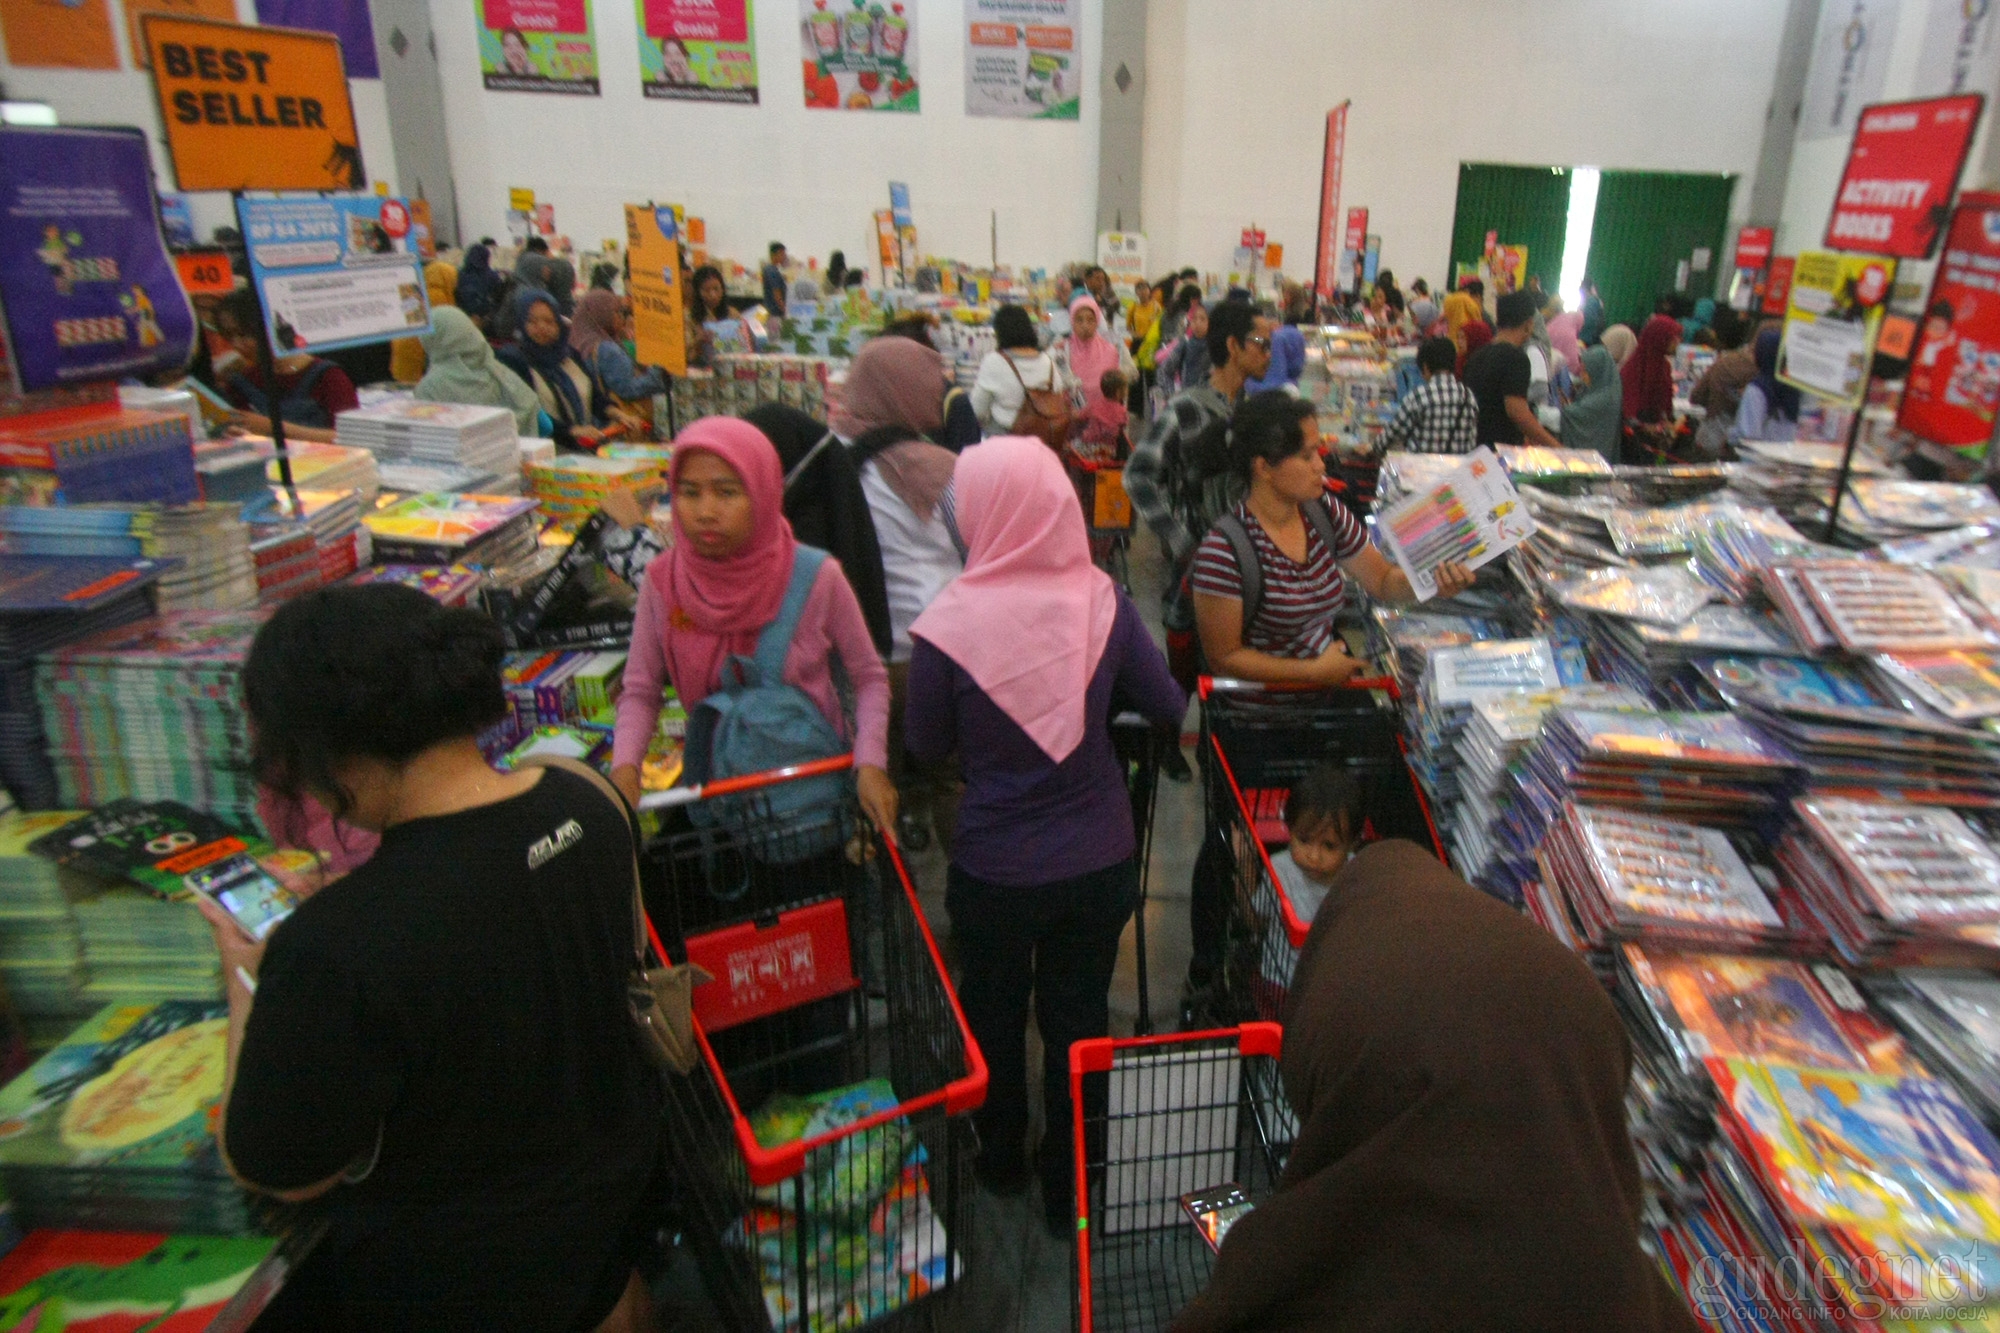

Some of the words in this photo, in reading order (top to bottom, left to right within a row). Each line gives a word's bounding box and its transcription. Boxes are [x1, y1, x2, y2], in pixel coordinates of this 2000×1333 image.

[161, 42, 271, 84] BEST
[173, 90, 327, 128] SELLER
[1840, 179, 1931, 209] ACTIVITY
[191, 265, 221, 285] 40
